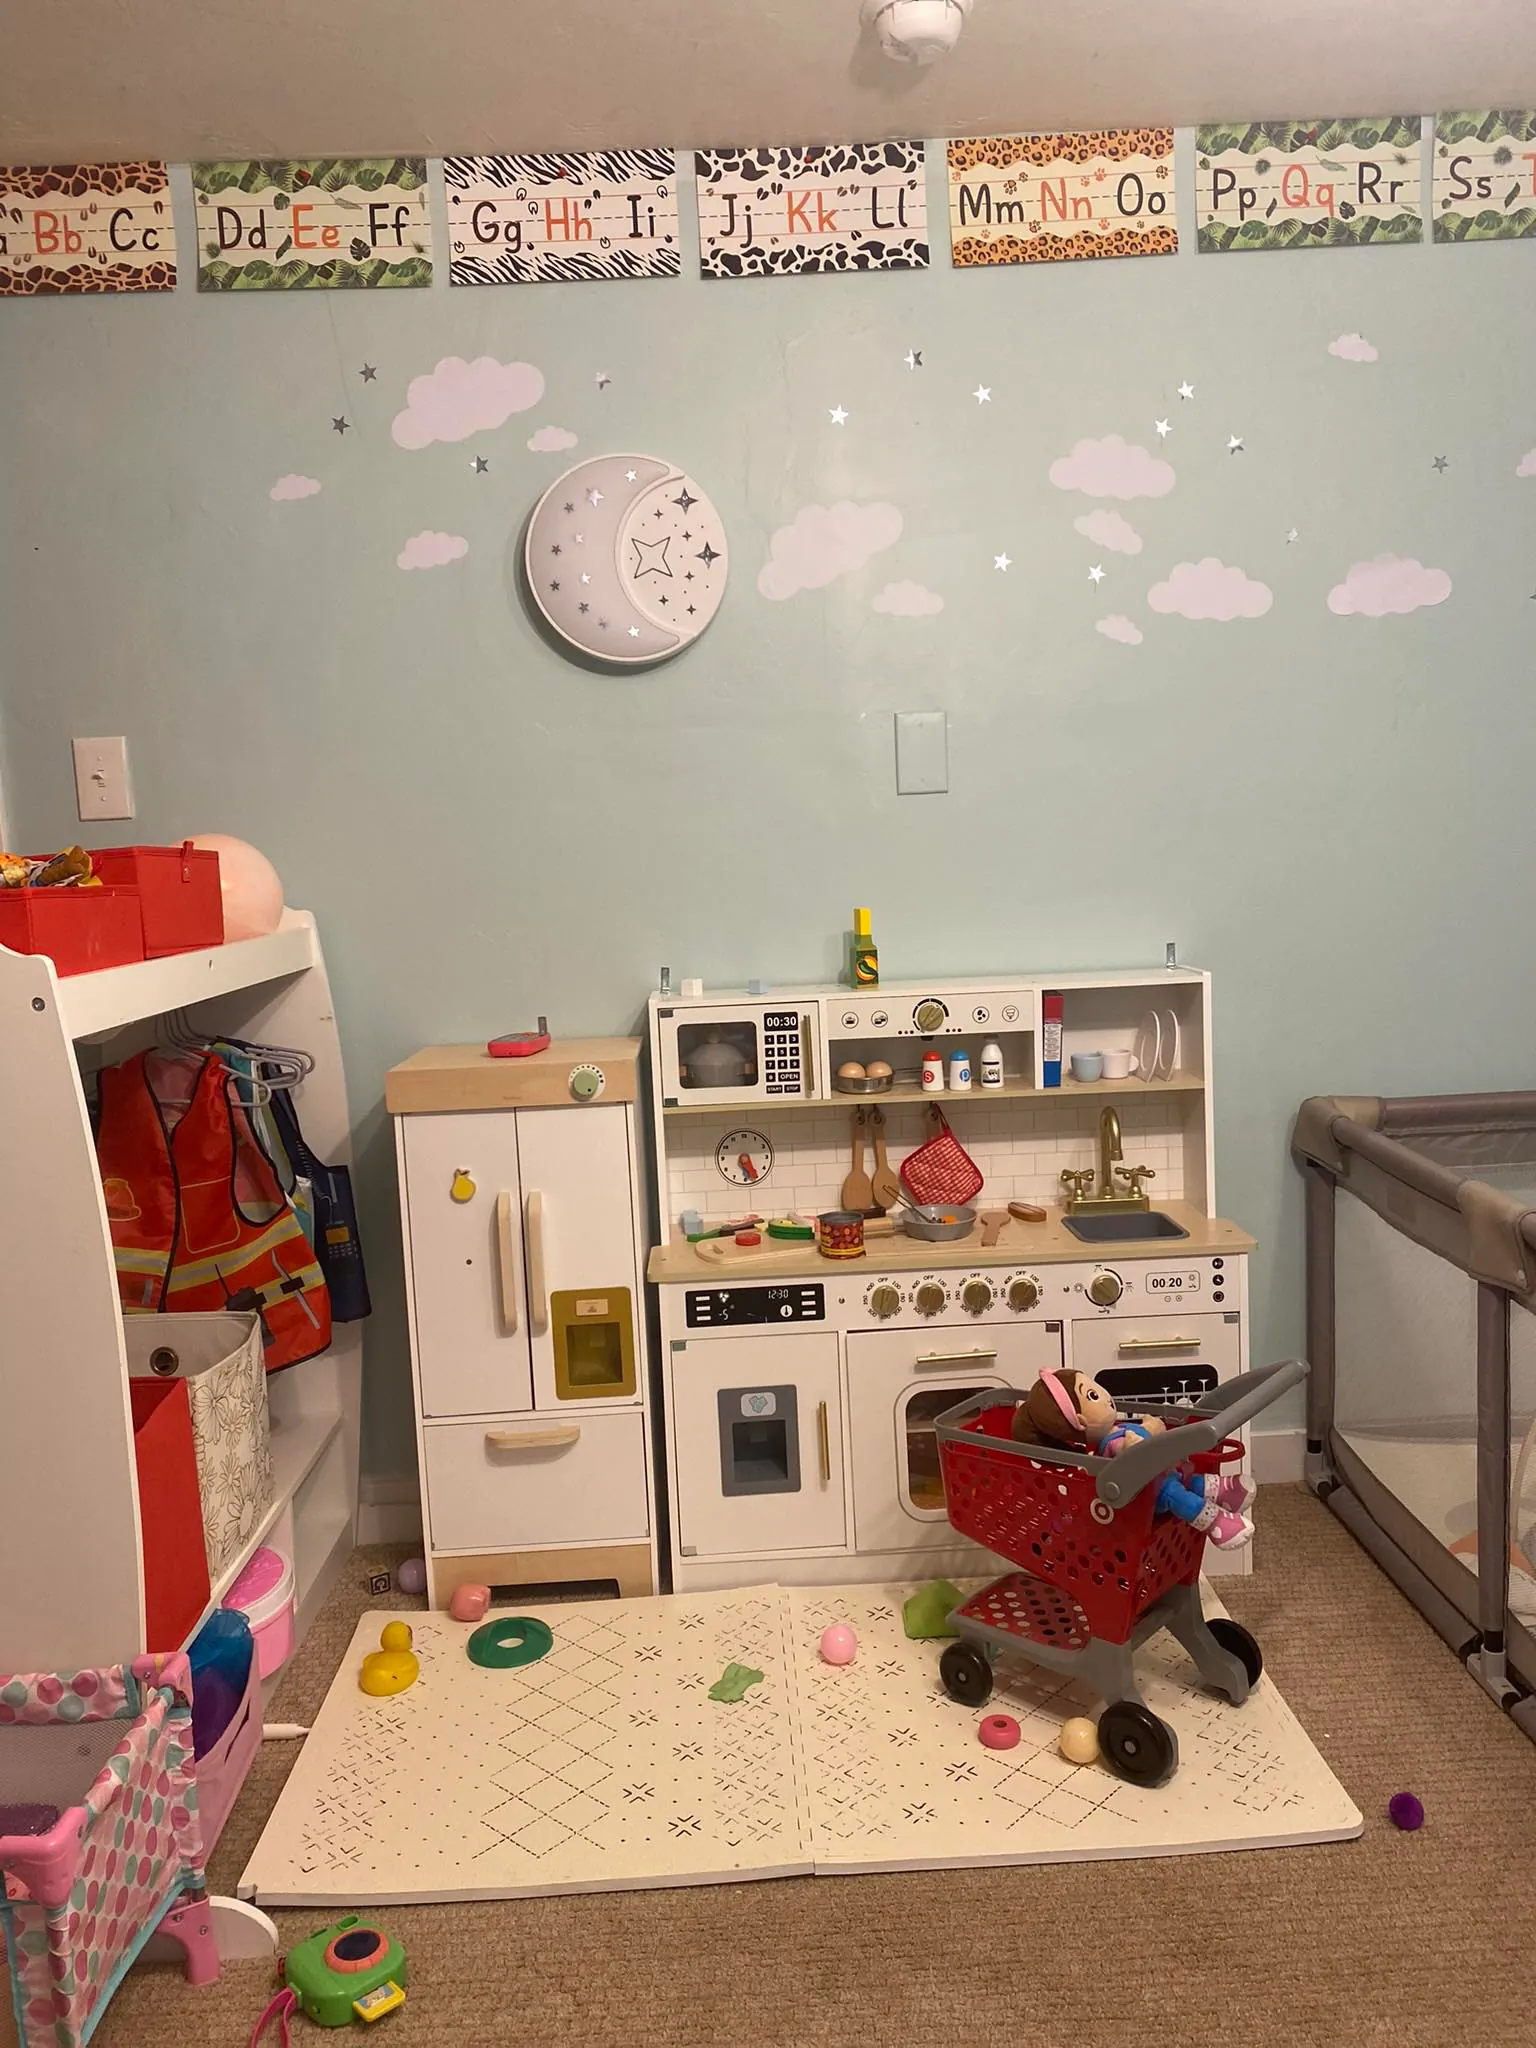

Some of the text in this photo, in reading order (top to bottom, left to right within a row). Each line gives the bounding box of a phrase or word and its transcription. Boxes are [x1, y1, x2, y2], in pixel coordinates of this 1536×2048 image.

[959, 173, 1166, 226] Mm Nn Oo
[1212, 161, 1404, 220] Pp Qq Rr
[1449, 156, 1492, 200] Ss
[33, 211, 82, 255] Bb
[109, 208, 160, 251] Cc
[217, 203, 410, 250] Dd Ee Ff
[472, 194, 655, 253] Gg Hh Ii
[720, 187, 907, 248] Jj Kk Ll
[766, 1016, 797, 1027] 00:30
[768, 1289, 789, 1300] 12:30
[892, 1281, 901, 1290] 100
[937, 1279, 947, 1288] 100
[984, 1276, 994, 1285] 100
[1030, 1274, 1040, 1283] 100
